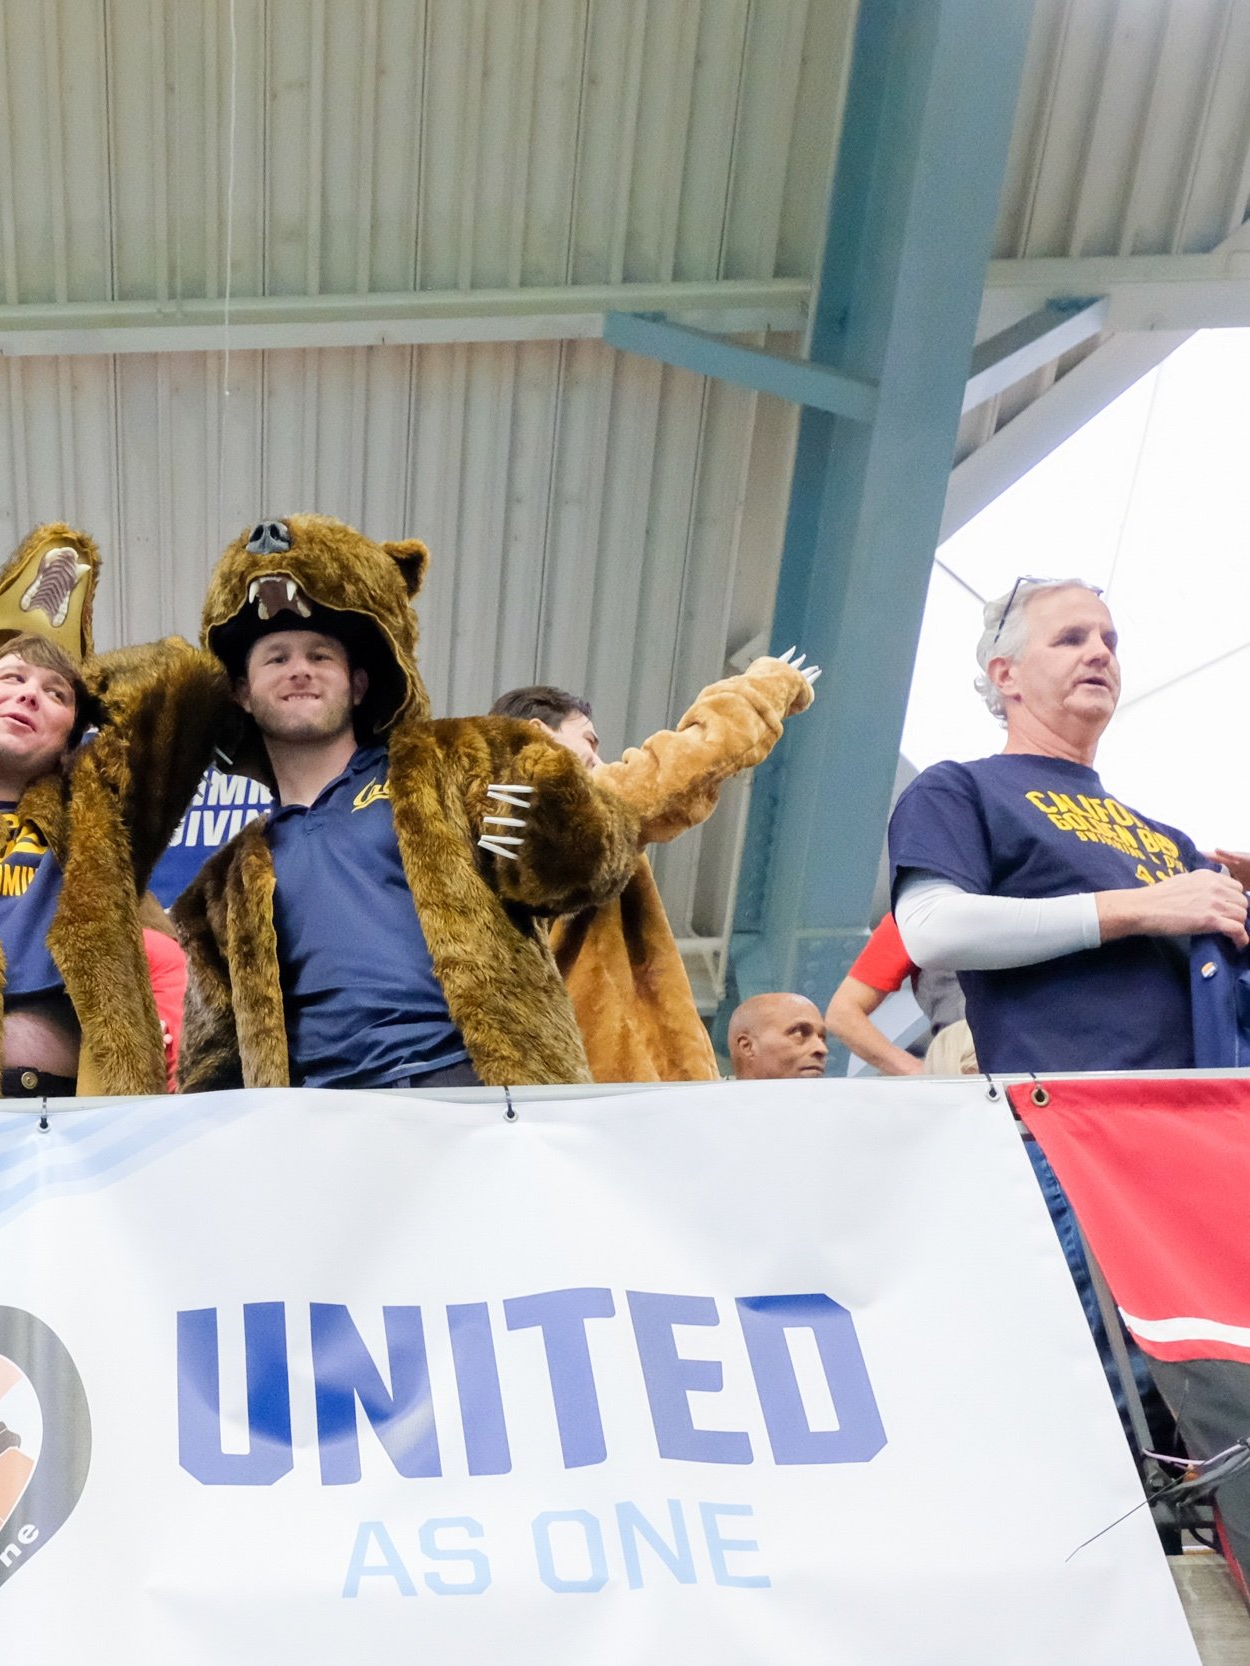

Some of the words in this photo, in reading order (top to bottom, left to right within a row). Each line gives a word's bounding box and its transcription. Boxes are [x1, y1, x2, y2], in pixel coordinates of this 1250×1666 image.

[177, 1287, 888, 1486] UNITED
[342, 1516, 492, 1598] AS
[531, 1498, 772, 1594] ONE
